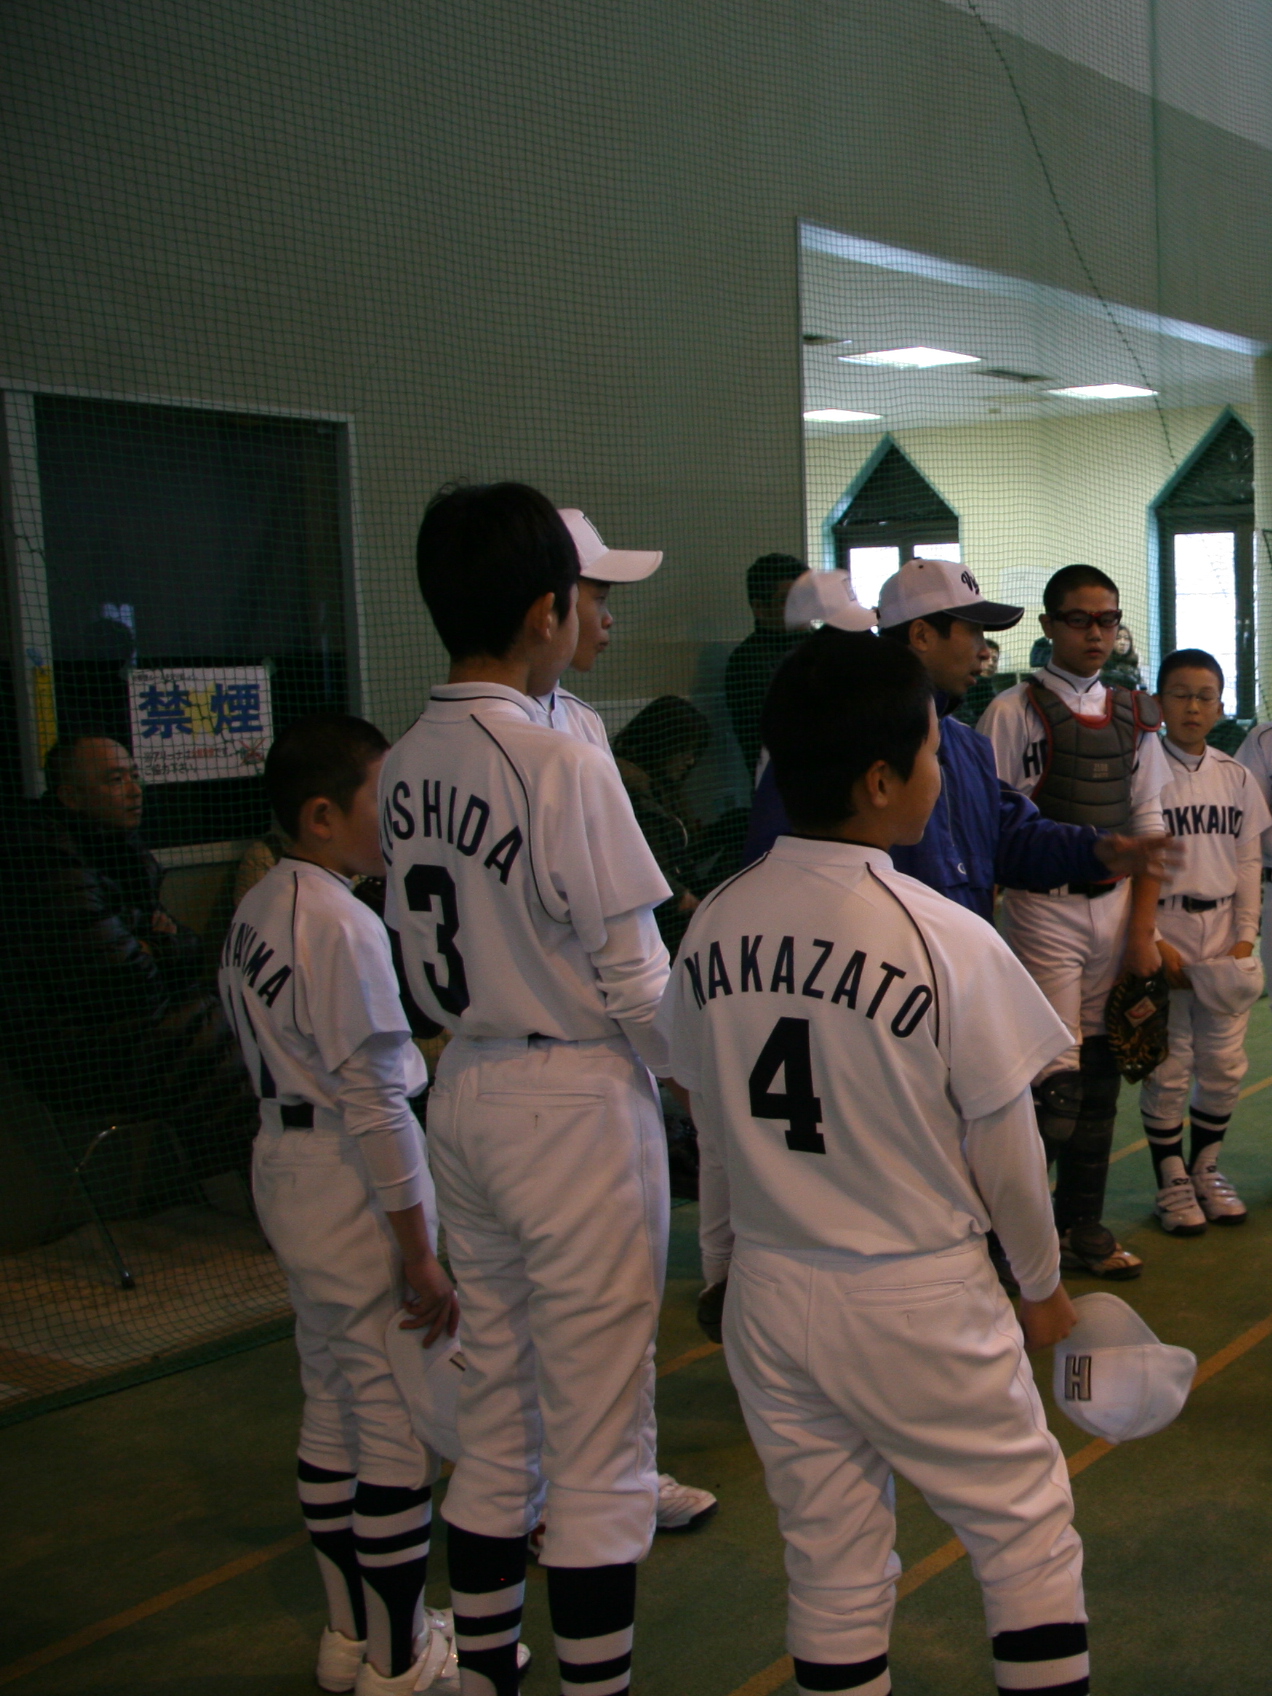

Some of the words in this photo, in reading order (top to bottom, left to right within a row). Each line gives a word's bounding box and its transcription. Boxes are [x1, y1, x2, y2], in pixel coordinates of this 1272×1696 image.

[139, 683, 263, 739] 禁煙
[381, 779, 523, 885] SHIDA
[1162, 804, 1243, 838] OKKAIDO
[404, 864, 470, 1017] 3
[684, 935, 933, 1038] NAKAZATO
[749, 1017, 826, 1154] 4
[1064, 1355, 1092, 1401] H
